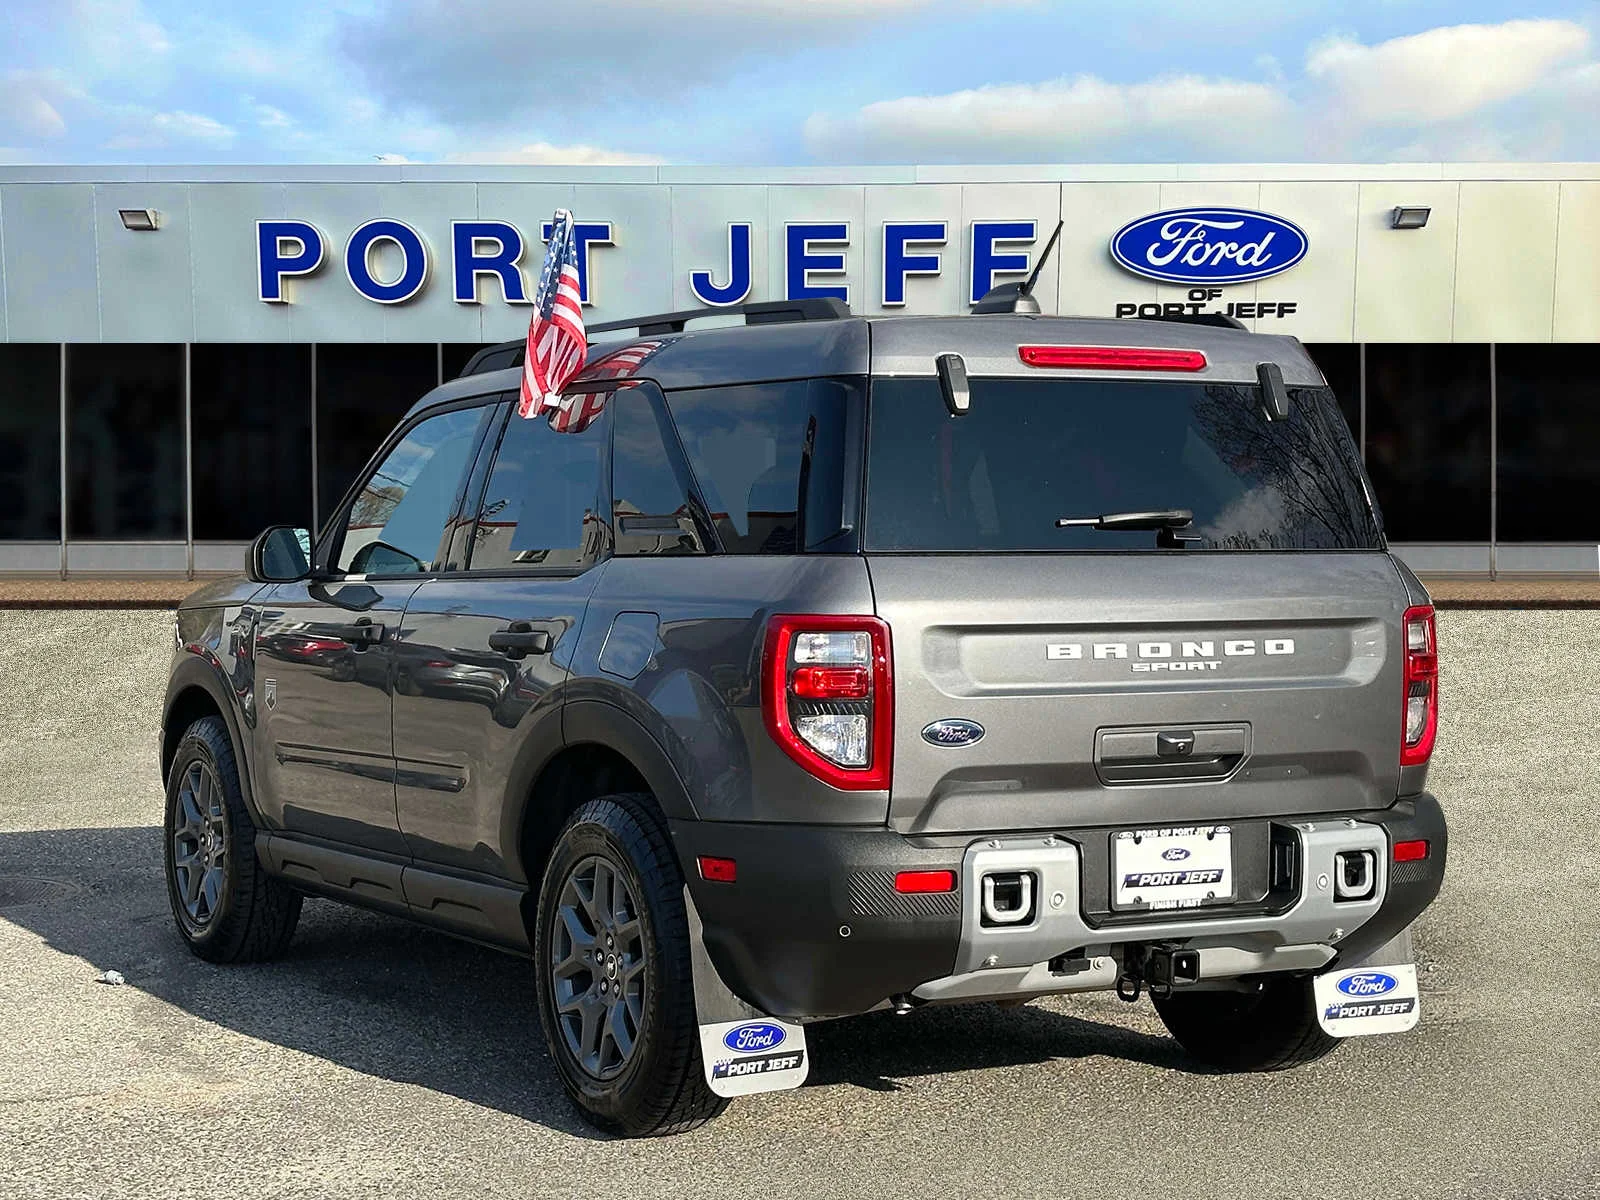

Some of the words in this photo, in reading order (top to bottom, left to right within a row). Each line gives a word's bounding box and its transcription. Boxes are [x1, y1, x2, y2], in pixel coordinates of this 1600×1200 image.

[1146, 218, 1277, 267] Ford
[256, 218, 615, 305] PORT
[689, 220, 1037, 306] JEFF
[1188, 289, 1223, 301] OF
[1116, 303, 1206, 318] PORT
[1215, 303, 1297, 318] JEFF
[1046, 639, 1295, 660] BRONCO
[1131, 661, 1222, 672] SPORT
[938, 726, 970, 740] Ford
[1160, 829, 1172, 837] OF
[1166, 848, 1186, 860] Ford
[1139, 873, 1181, 886] PORT
[1181, 870, 1219, 883] JEFF
[1348, 976, 1386, 993] Ford
[1339, 1005, 1376, 1018] PORT
[1377, 1002, 1410, 1015] JEFF
[736, 1027, 774, 1048] Ford
[727, 1061, 765, 1076] PORT
[766, 1056, 799, 1071] JEFF
